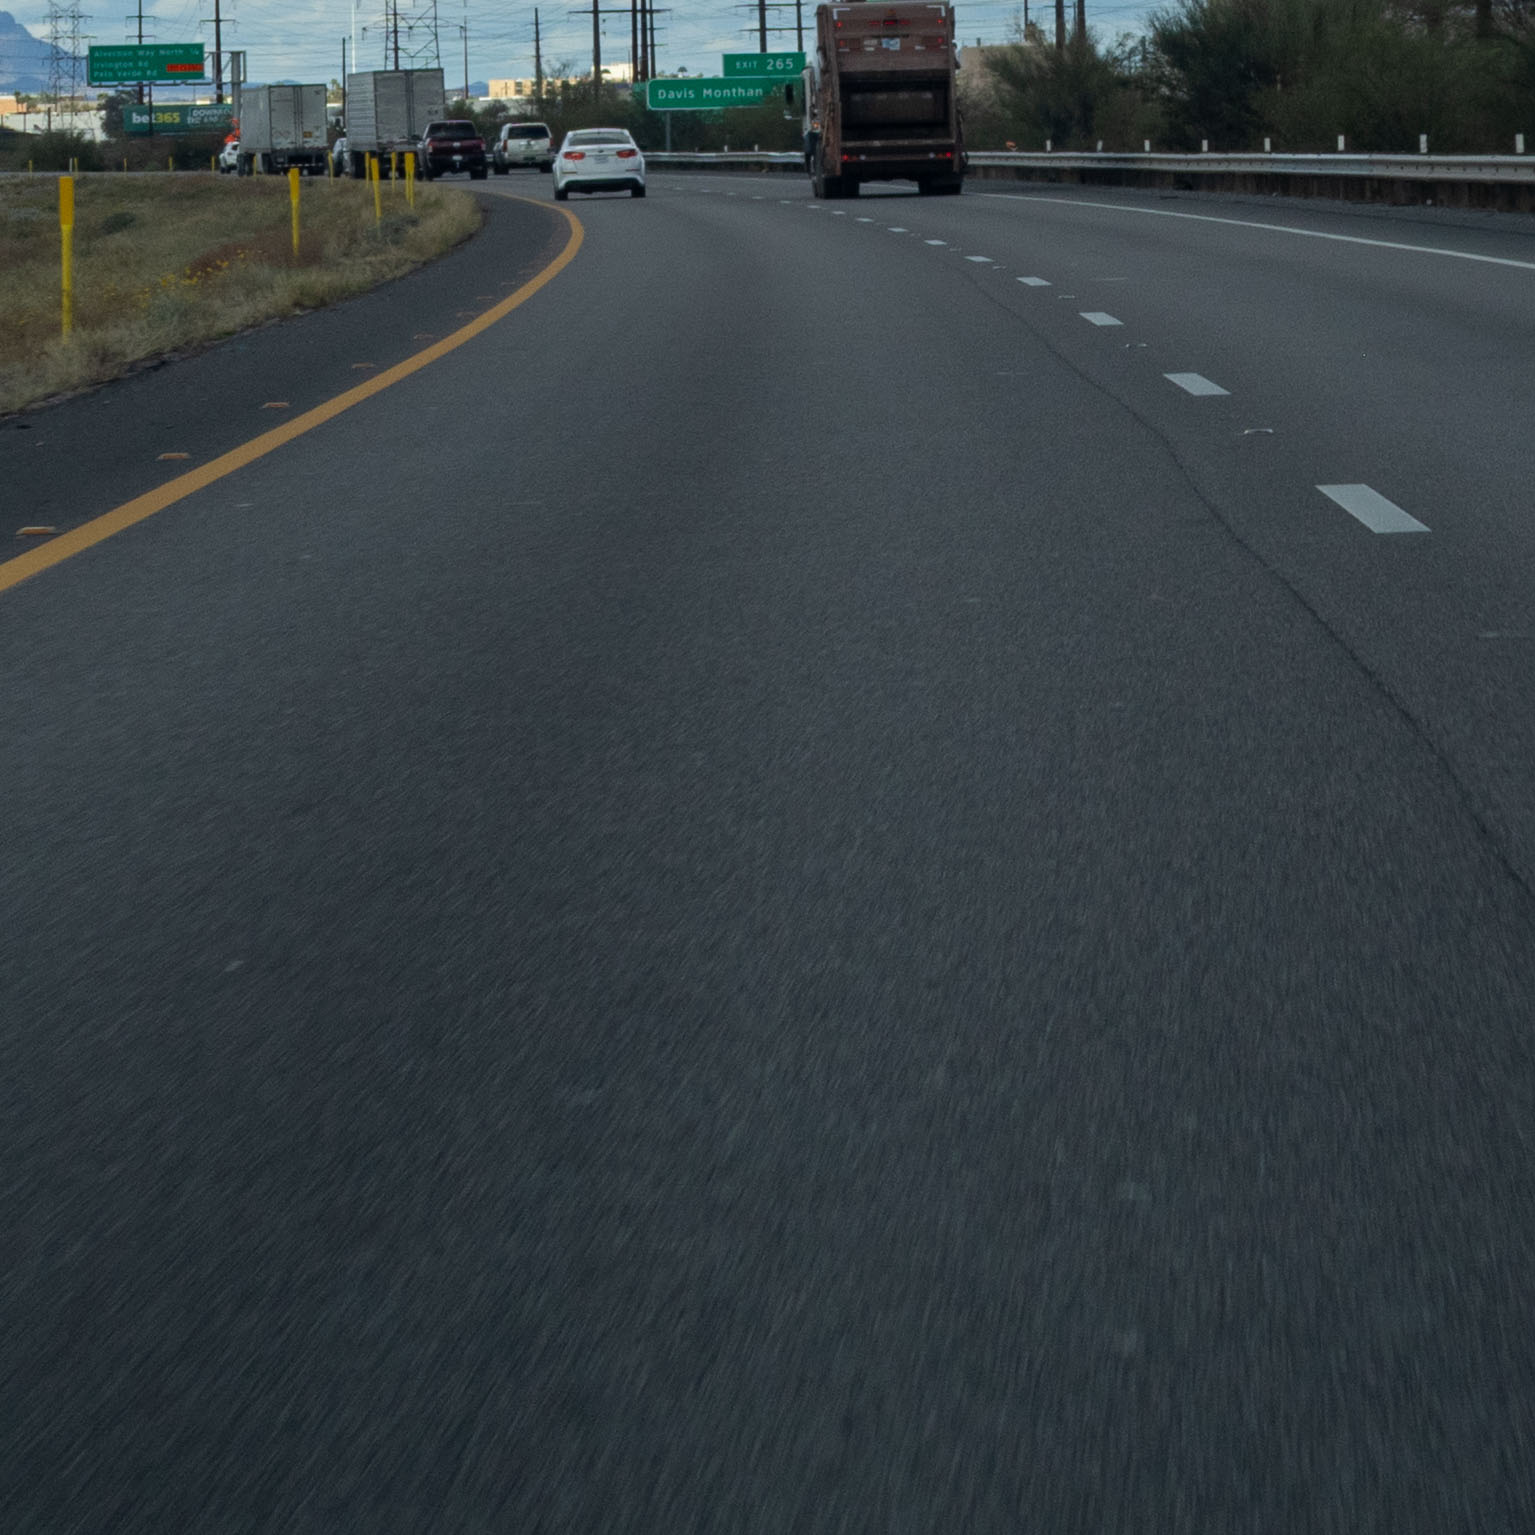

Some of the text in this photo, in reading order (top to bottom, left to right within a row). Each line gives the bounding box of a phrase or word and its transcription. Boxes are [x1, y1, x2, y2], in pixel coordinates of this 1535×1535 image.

[138, 49, 155, 57] Way
[159, 48, 184, 56] North
[735, 58, 794, 70] EXIT 265
[657, 88, 695, 99] Davis
[702, 86, 763, 98] Monthan
